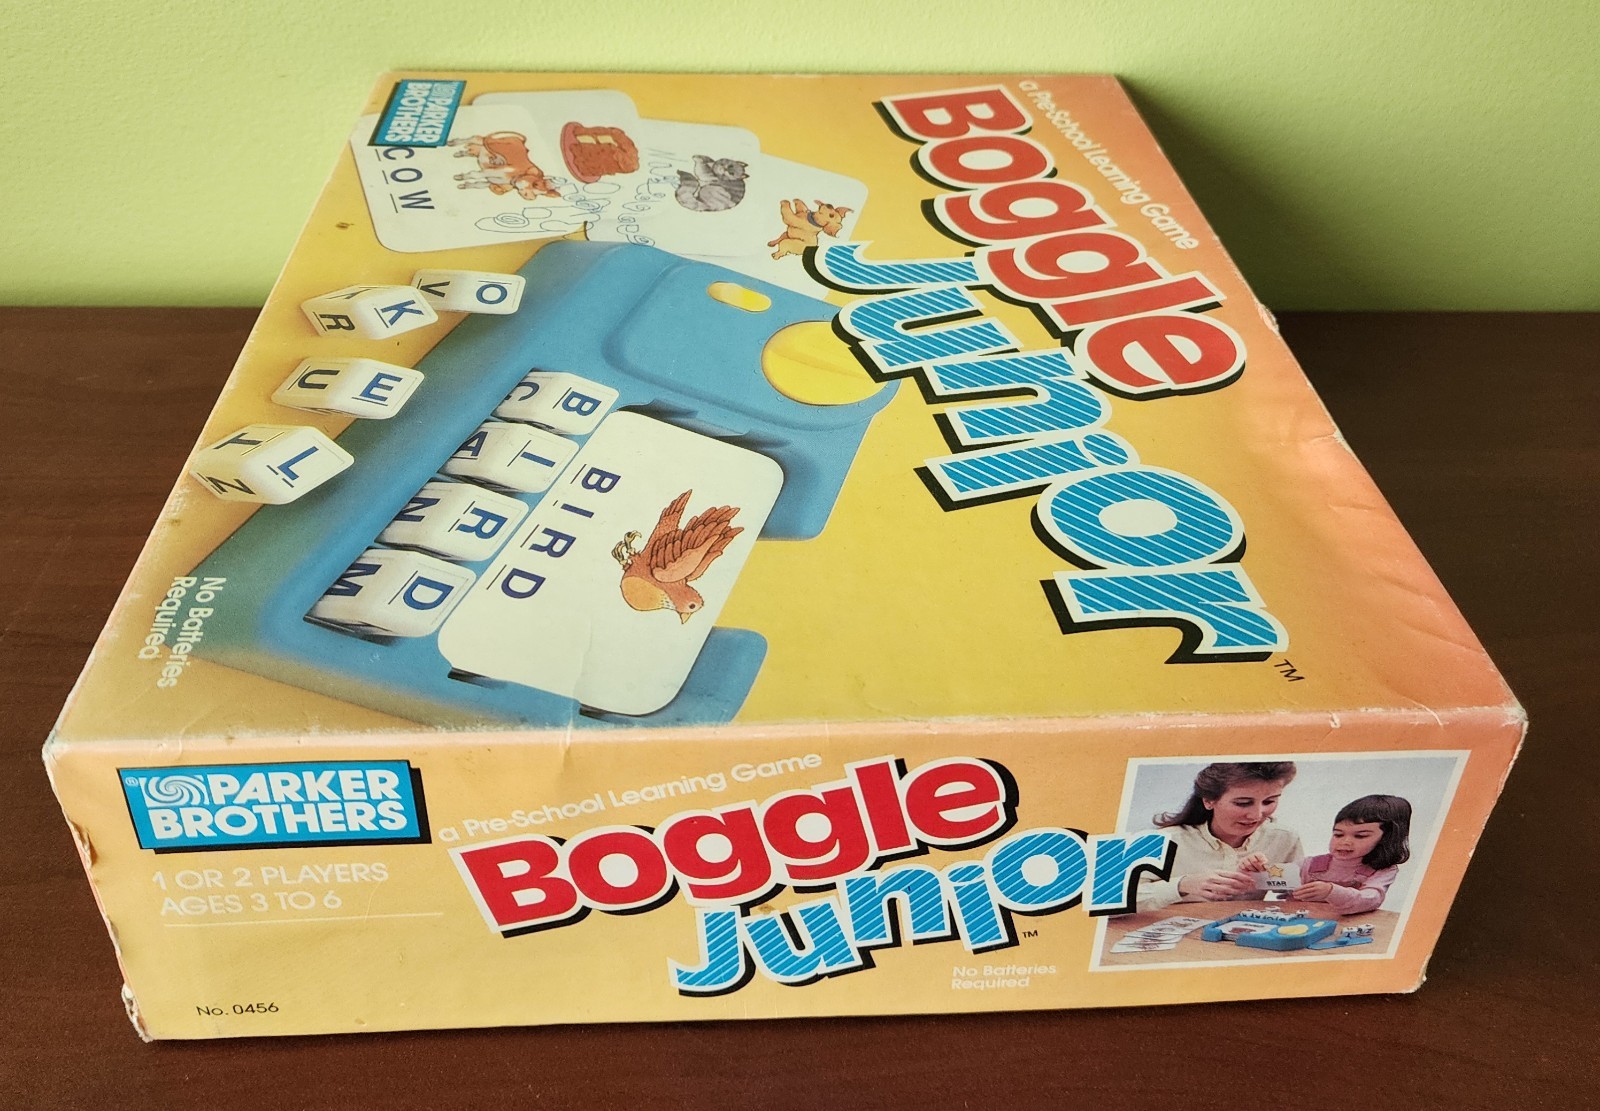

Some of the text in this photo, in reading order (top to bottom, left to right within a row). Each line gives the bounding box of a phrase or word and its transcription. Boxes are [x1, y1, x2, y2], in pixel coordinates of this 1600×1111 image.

[384, 82, 433, 142] BROTHERS
[412, 97, 453, 143] PARKER
[1018, 80, 1199, 250] a Pre-School Learning Game
[880, 83, 1248, 396] Boggle
[137, 576, 198, 660] Required
[156, 576, 227, 689] No Batteries
[206, 768, 402, 806] PARKER
[438, 751, 823, 843] a Pre-School Learning Game
[147, 800, 408, 840] BROTHERS
[447, 753, 1010, 936] Boggle
[151, 861, 390, 891] 1 OR 2 PLAYERS
[160, 888, 343, 917] AGES 3 TO 6
[951, 976, 1031, 991] Required
[952, 963, 1057, 978] No Batteries
[195, 1001, 280, 1017] No. 0456
